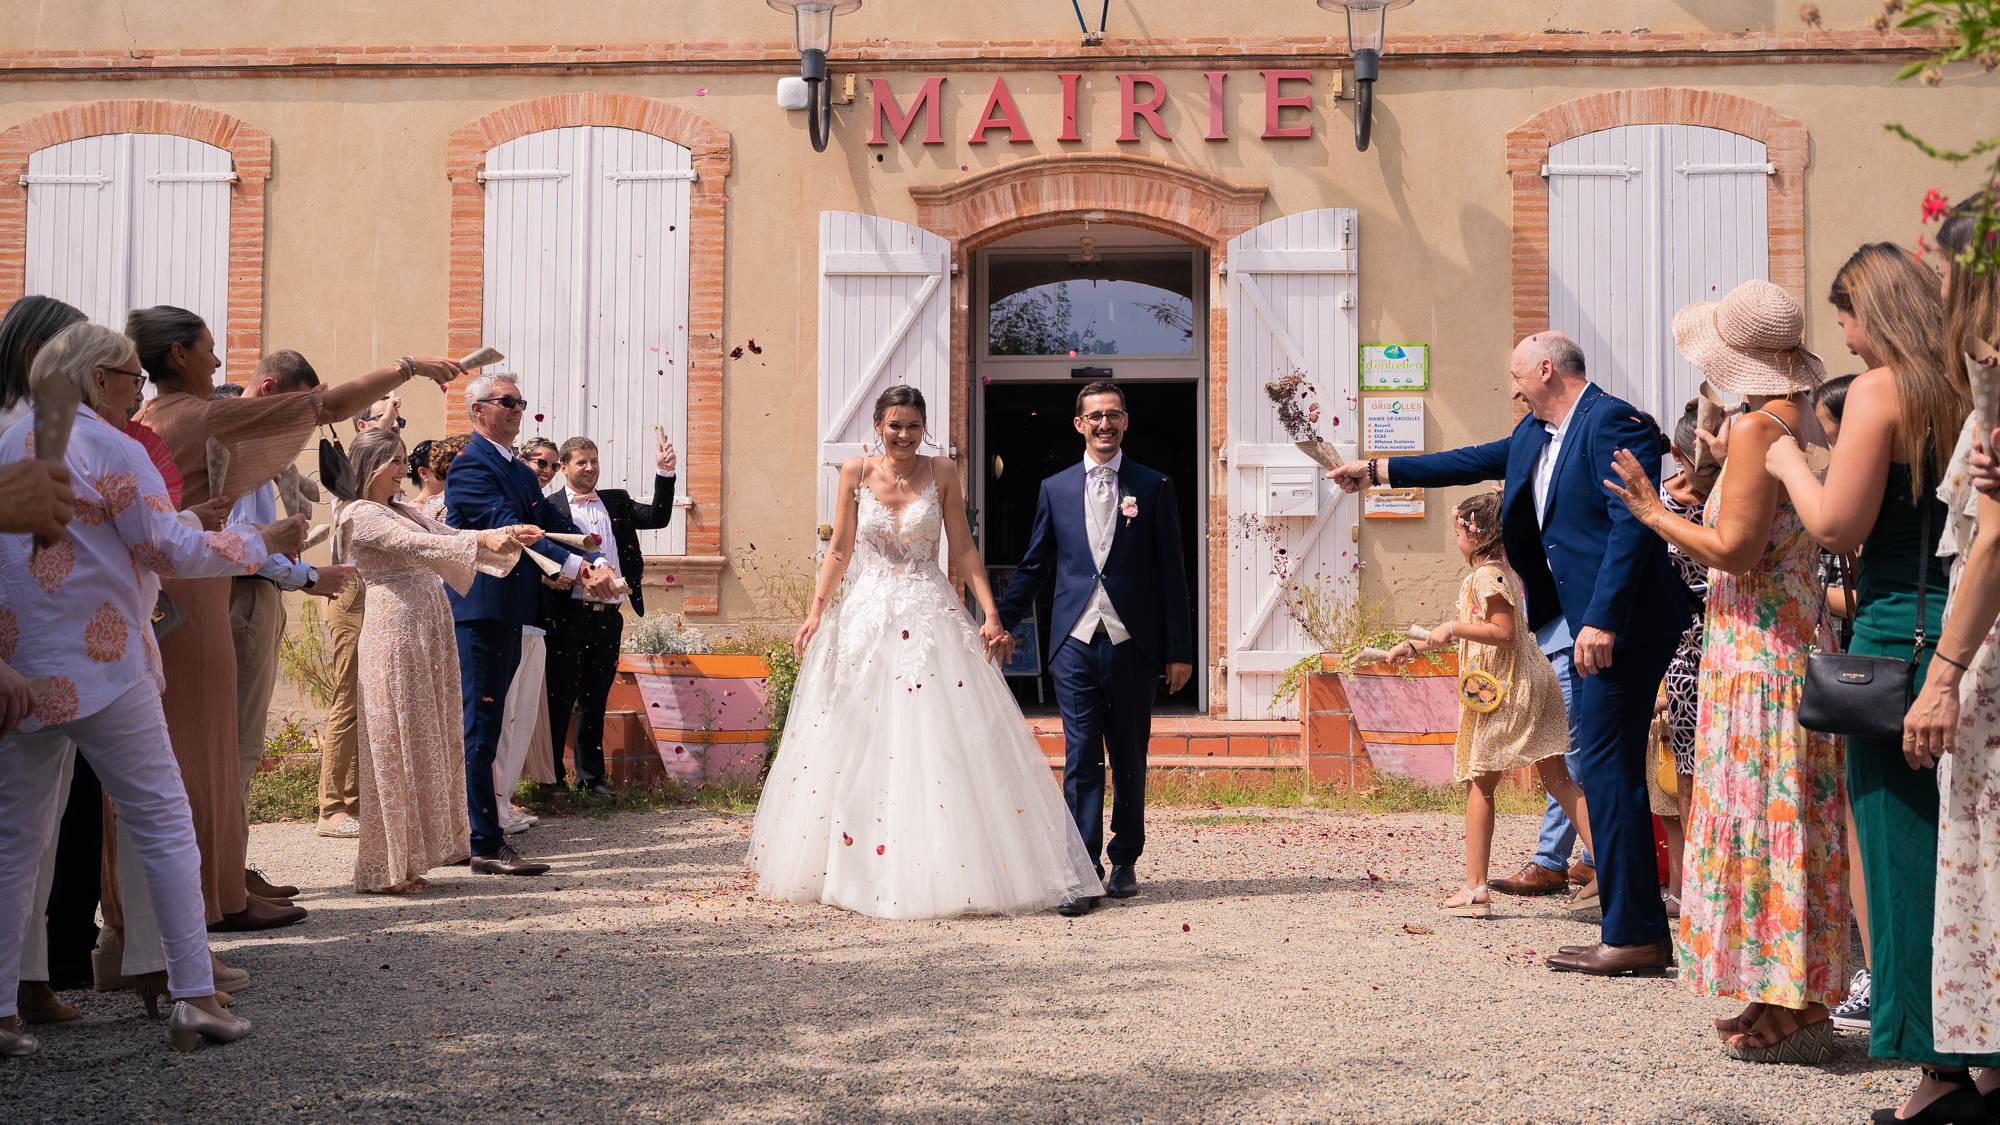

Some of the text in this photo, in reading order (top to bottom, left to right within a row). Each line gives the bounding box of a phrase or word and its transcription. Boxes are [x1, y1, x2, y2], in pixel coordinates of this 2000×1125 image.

[866, 69, 1314, 146] MAIRIE
[1366, 358, 1422, 369] d'entretien
[1372, 401, 1422, 410] GRISOLLES
